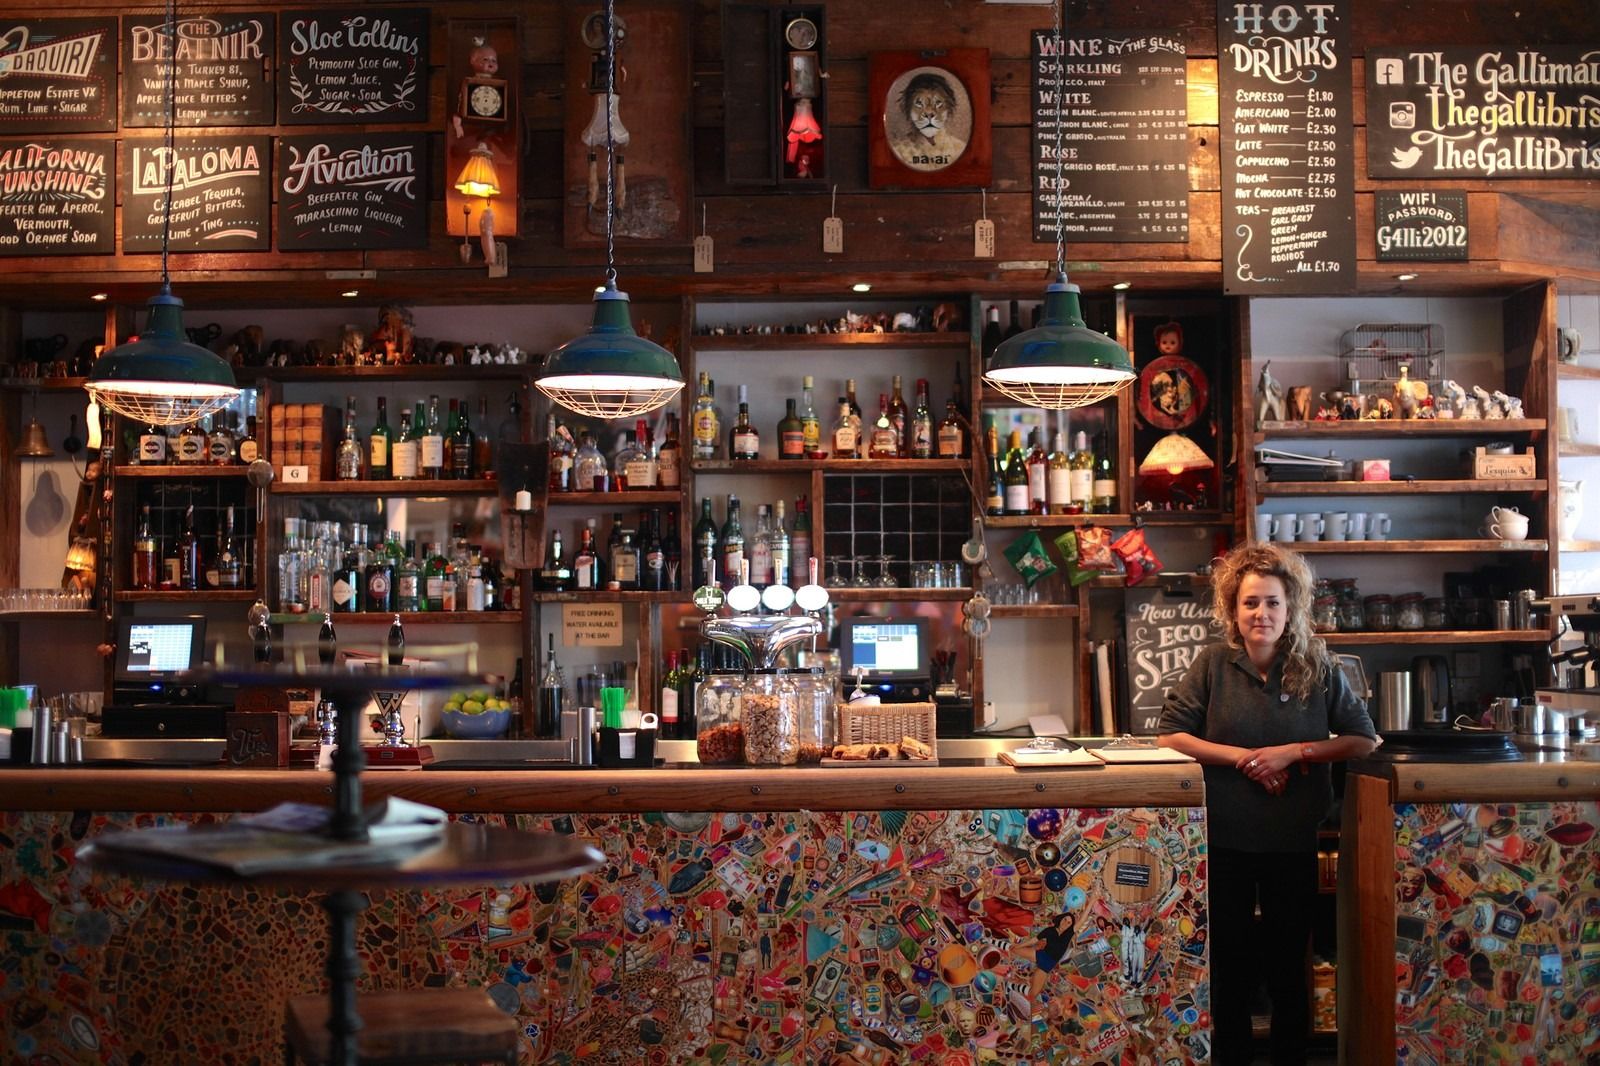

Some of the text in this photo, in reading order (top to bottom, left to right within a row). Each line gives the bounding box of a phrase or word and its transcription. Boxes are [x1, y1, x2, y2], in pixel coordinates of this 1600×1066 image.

[1234, 3, 1335, 34] HOT
[189, 23, 210, 35] THE
[290, 16, 418, 55] Sloe Collins
[1036, 35, 1186, 56] WINE BY THE GLASS
[13, 36, 97, 74] DAQUIRI
[1230, 36, 1337, 81] DRINKS
[187, 63, 225, 75] TURKEY
[308, 56, 355, 70] PLYMOUTH
[357, 56, 380, 70] SLOE
[1038, 60, 1122, 73] SPARKLING
[1409, 52, 1468, 93] The
[143, 78, 180, 89] VANILA
[184, 78, 215, 89] MAPLE
[315, 74, 346, 86] LEMON
[46, 85, 80, 99] ESTATE
[82, 86, 97, 97] VX
[136, 94, 162, 104] APPLE
[200, 93, 237, 103] BITTERS
[320, 88, 382, 101] SUGAR SODA
[1235, 89, 1333, 102] ESPRESSO £1.80
[27, 102, 49, 114] LIME
[58, 101, 87, 113] SUGAR
[176, 108, 207, 118] LEMON
[1235, 106, 1336, 118] AMERICANO £2.00
[1234, 123, 1336, 135] FLAT WHITE £2.30
[1235, 139, 1336, 151] LATTE £2.50
[0, 143, 107, 176] ALIFORNIA
[1235, 155, 1336, 167] CAPPUCCINO £2.50
[283, 143, 416, 194] Aviation
[1235, 172, 1336, 184] MOCHA £2.75
[306, 191, 359, 206] BEEFEATER
[1235, 188, 1336, 199] HOT CHOCOLATE £2.50
[1400, 193, 1436, 205] WIFI
[0, 204, 35, 216] FEATER
[147, 208, 201, 224] GRAEFRUIT
[294, 207, 360, 226] MARASCHINO
[1235, 204, 1316, 216] TEAS BREAKFAST
[1270, 213, 1313, 226] EARL GREY
[168, 218, 223, 240] LIME TING
[328, 222, 363, 233] LEMON
[1271, 224, 1298, 236] GREEN
[25, 231, 68, 244] ORANGE
[71, 230, 97, 243] SODA
[1271, 240, 1319, 254] PEPPERMINT
[1271, 251, 1305, 263] ROOIBOS
[1314, 260, 1340, 273] £1.70
[290, 469, 299, 478] G
[1138, 602, 1216, 624] Now Usi
[1158, 624, 1208, 648] ECO
[1098, 1023, 1122, 1043] LOST
[1092, 1029, 1129, 1053] WORLD
